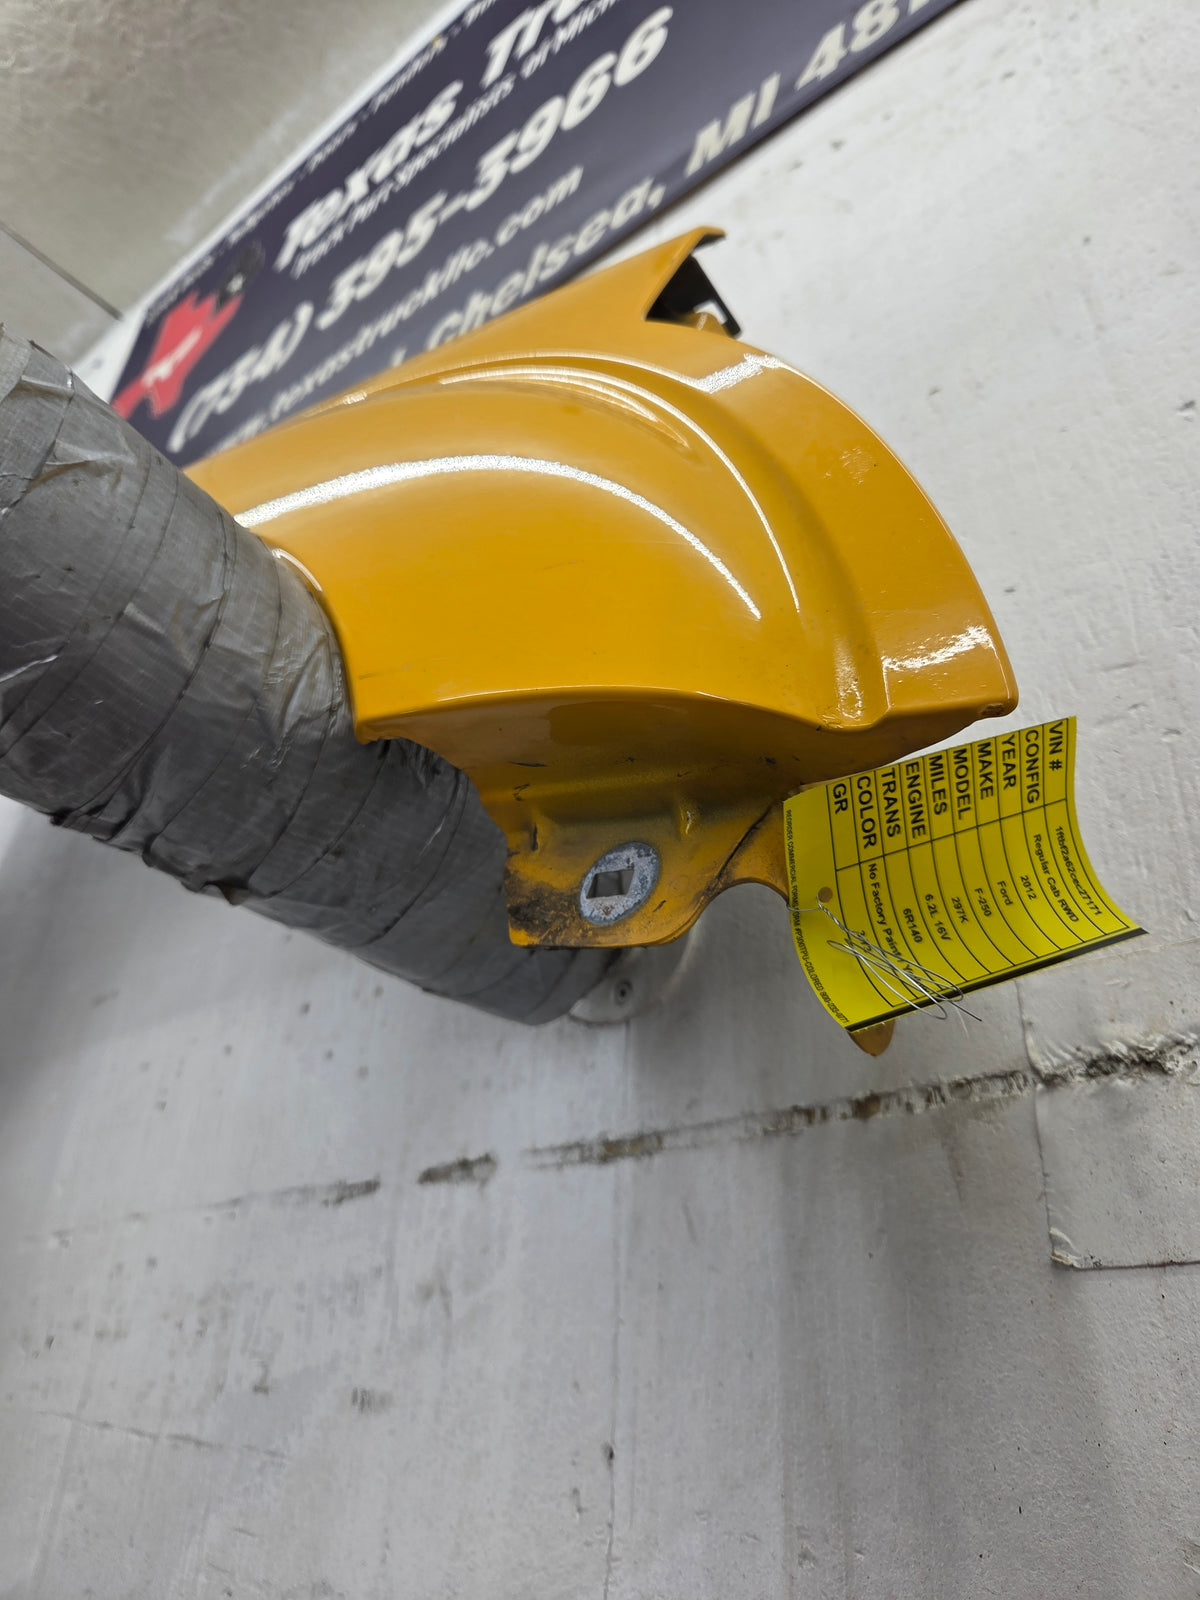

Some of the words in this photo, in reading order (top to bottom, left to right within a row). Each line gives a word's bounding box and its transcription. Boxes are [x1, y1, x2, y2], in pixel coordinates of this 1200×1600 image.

[393, 71, 517, 193] Specialists
[520, 36, 551, 80] of
[272, 79, 465, 273] Texas
[425, 177, 667, 353] Chelsea,
[684, 71, 781, 178] MI
[165, 300, 314, 452] (734)
[1001, 734, 1017, 790] YEAR
[1048, 721, 1064, 756] VIN
[927, 754, 948, 816] MILES
[953, 747, 972, 820] MODEL
[976, 741, 995, 800] MAKE
[1024, 729, 1041, 805] CONFIG
[1048, 759, 1063, 772] #
[831, 782, 849, 815] GR
[856, 775, 877, 850] COLOR
[881, 767, 901, 839] TRANS
[904, 762, 927, 840] ENGINE
[788, 841, 797, 885] COMMERCIAL
[868, 862, 878, 880] No
[1019, 875, 1038, 902] 2012
[1033, 833, 1050, 878] Regular
[1047, 877, 1061, 899] Cab
[1056, 898, 1080, 923] RWD
[871, 882, 887, 926] Factory
[924, 893, 939, 918] 6.2L
[934, 920, 952, 942] 16V
[951, 896, 969, 925] 297K
[974, 887, 992, 918] F-250
[996, 880, 1014, 906] Ford
[882, 927, 901, 957] Paint
[902, 907, 924, 944] 6R140
